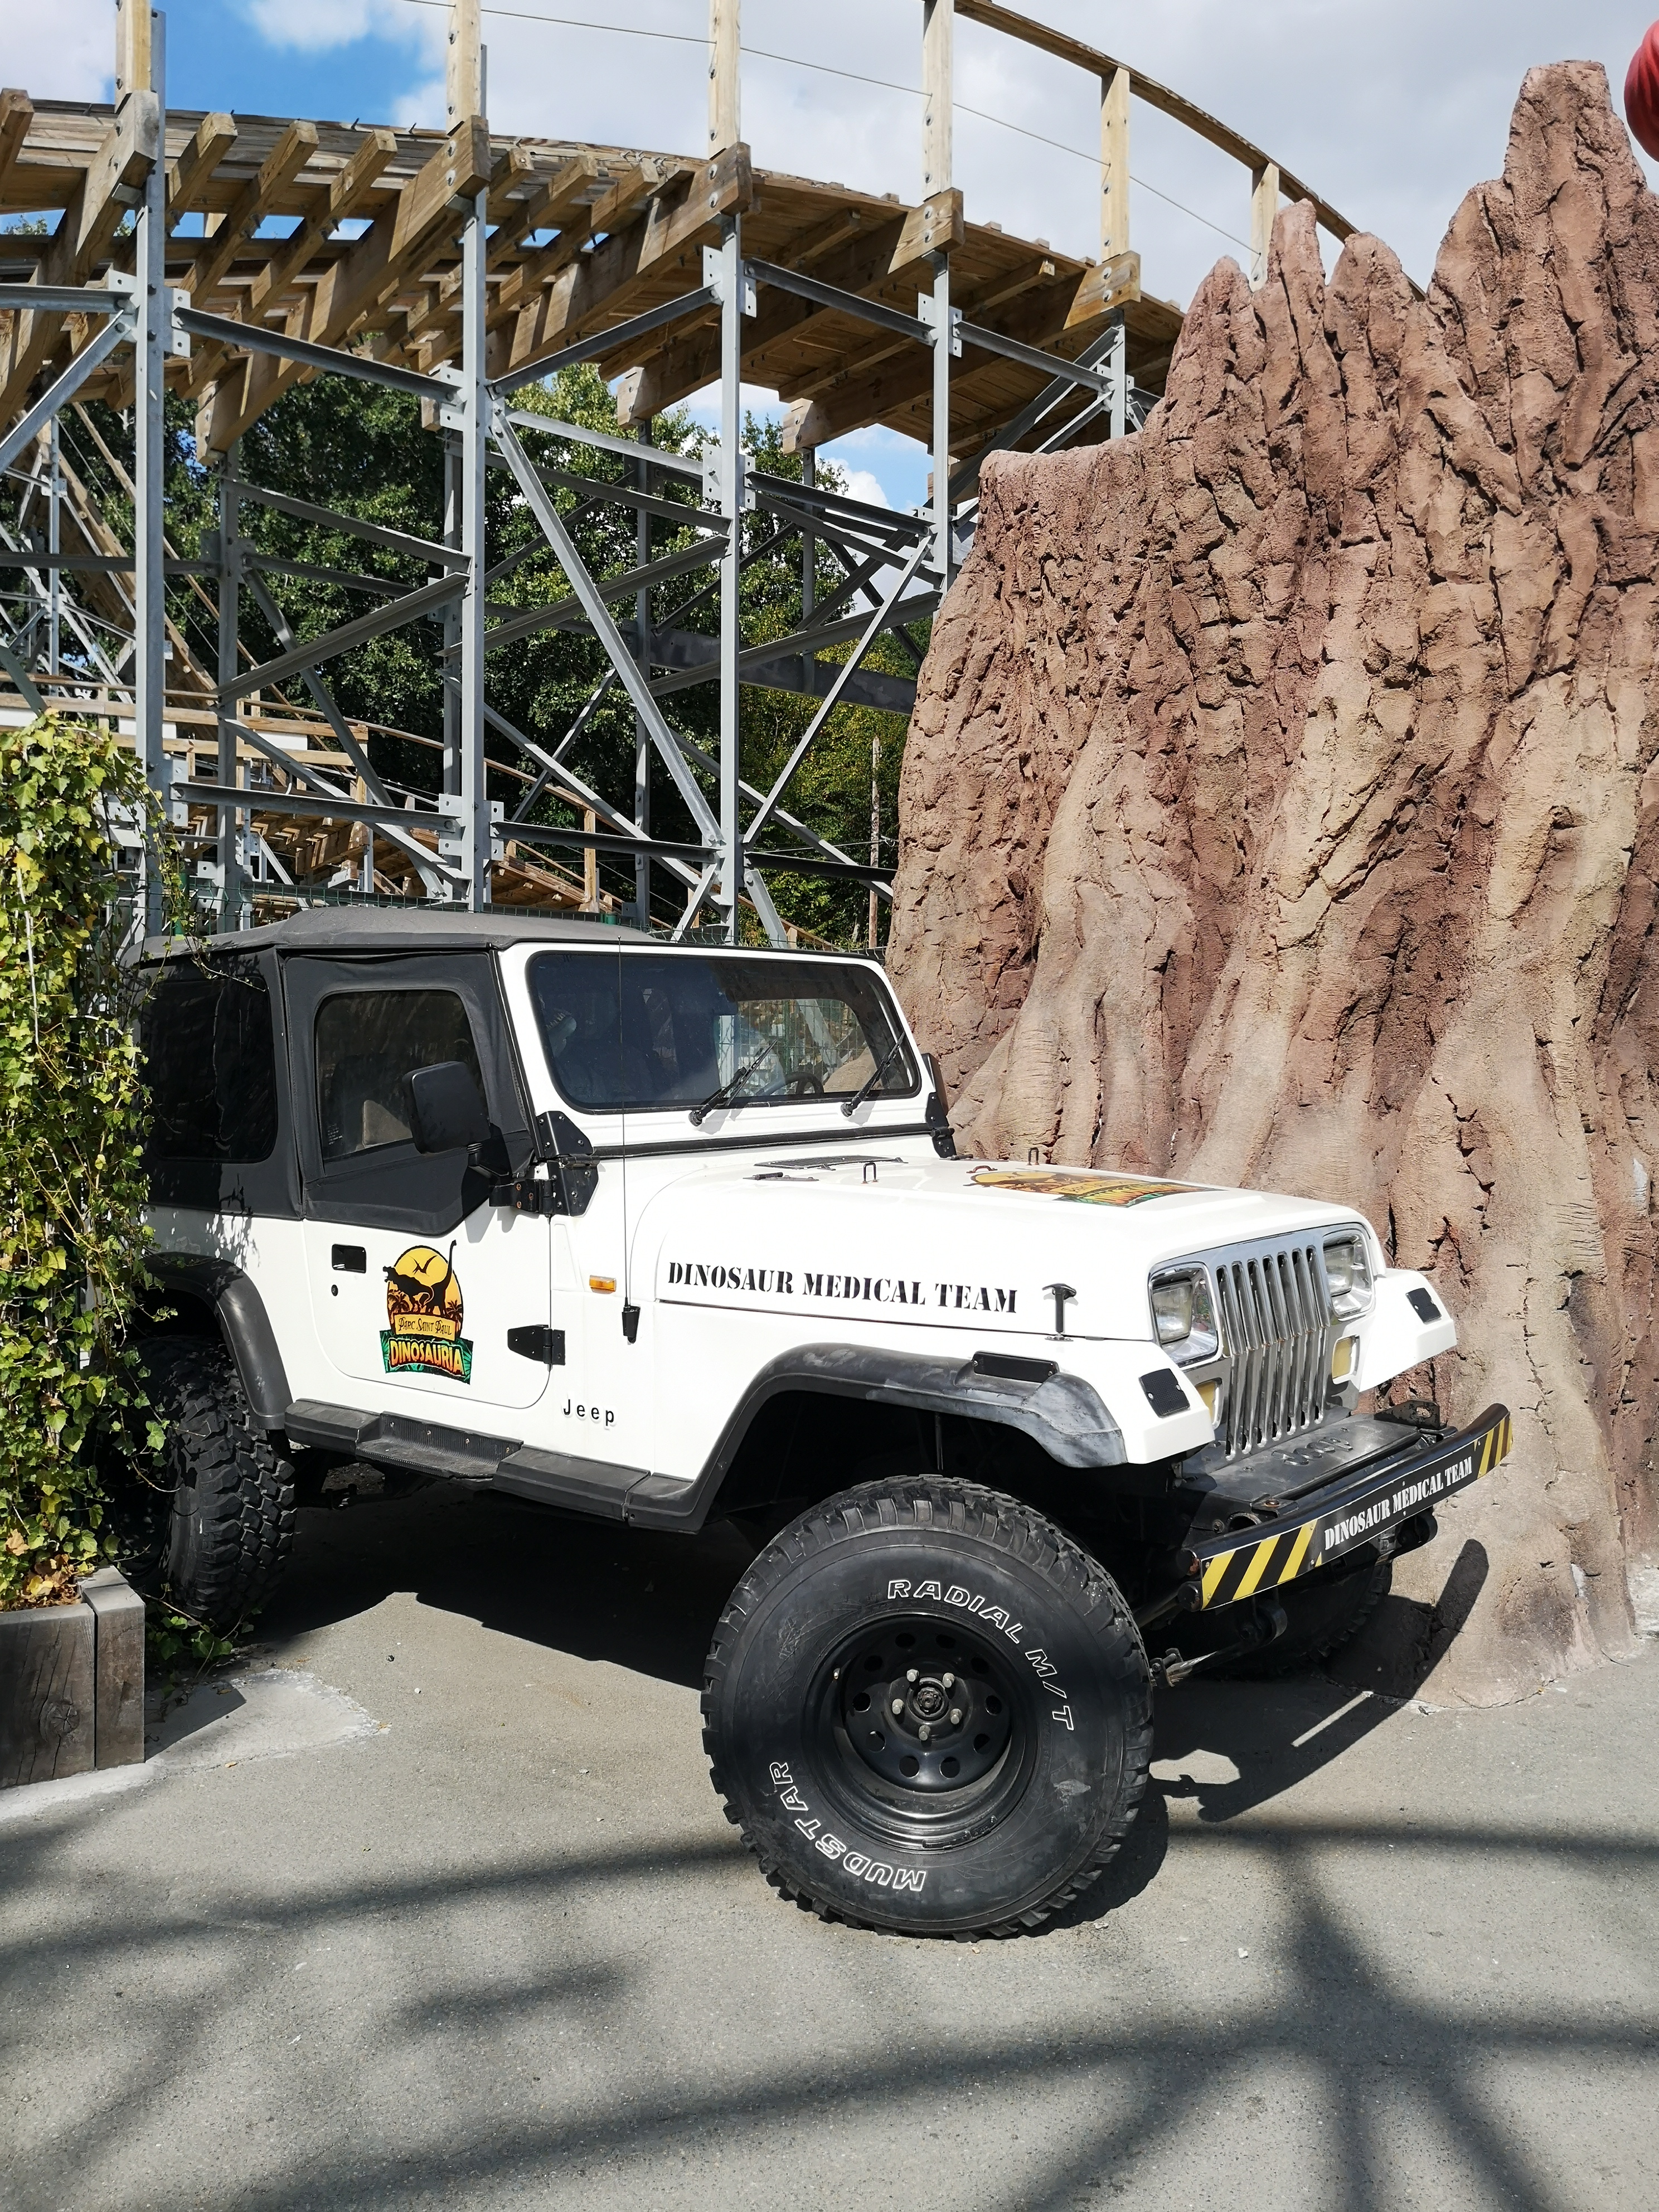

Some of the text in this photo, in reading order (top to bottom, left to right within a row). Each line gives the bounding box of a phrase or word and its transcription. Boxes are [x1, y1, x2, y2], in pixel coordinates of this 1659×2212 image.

[668, 1262, 1018, 1313] DINOSAUR MEDICAL TEAM
[390, 1340, 464, 1375] DINOSAURIA
[563, 1399, 614, 1426] Jeep
[1325, 1456, 1473, 1550] DINOSAUR MEDICAL TEAM
[887, 1579, 1075, 1731] RADIAL M/T
[768, 1761, 927, 1892] MUDSTAR
